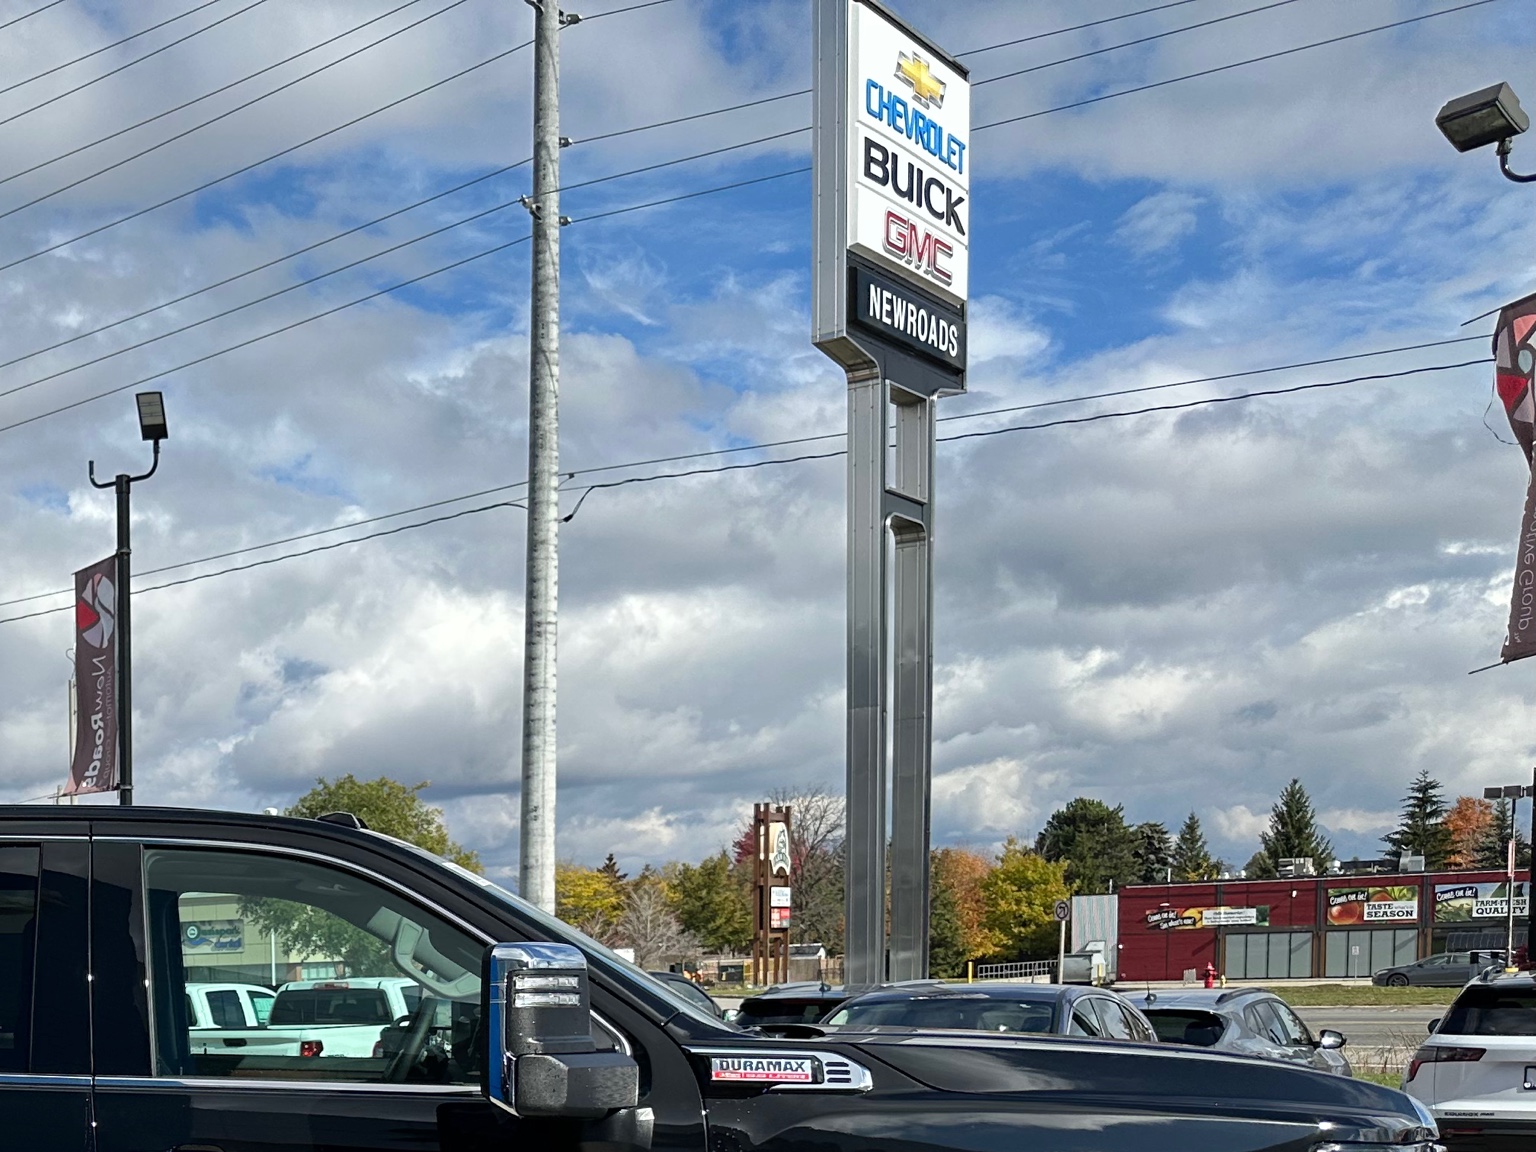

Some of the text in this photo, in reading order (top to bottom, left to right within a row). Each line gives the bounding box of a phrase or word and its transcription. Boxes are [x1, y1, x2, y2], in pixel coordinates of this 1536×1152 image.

[866, 78, 966, 174] CHEVROLET
[864, 137, 965, 236] BUICK
[884, 207, 953, 285] GMC
[869, 284, 958, 358] NEWROADS
[1366, 910, 1414, 918] SEASON
[1475, 899, 1527, 907] FARM-FESH
[1476, 907, 1525, 915] QUALTY
[720, 1060, 805, 1072] DURAMAX
